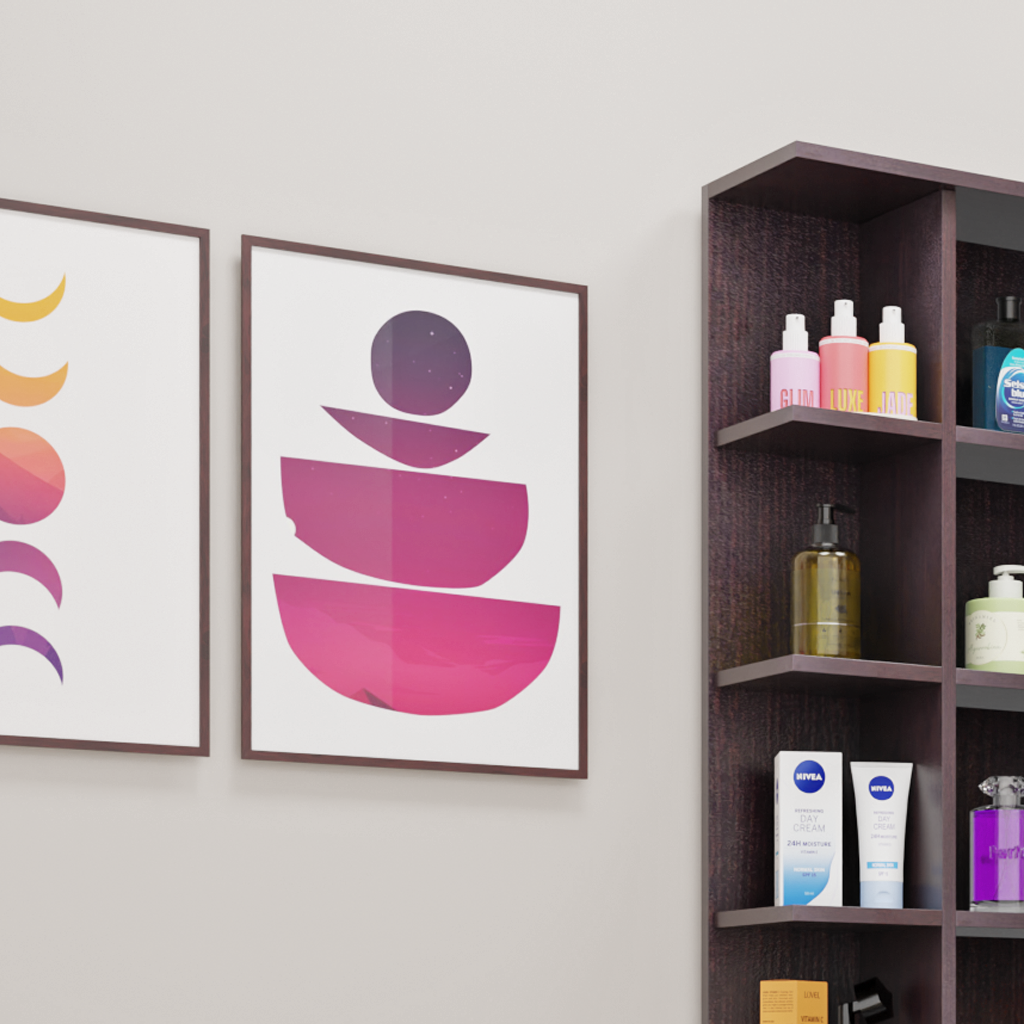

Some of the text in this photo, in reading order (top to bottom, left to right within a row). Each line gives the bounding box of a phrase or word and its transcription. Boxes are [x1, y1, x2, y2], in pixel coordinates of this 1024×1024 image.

[830, 388, 864, 412] LUXE
[877, 391, 914, 416] JADE
[796, 773, 823, 781] NIVEA
[800, 814, 819, 823] DAY
[793, 823, 826, 832] CREAM
